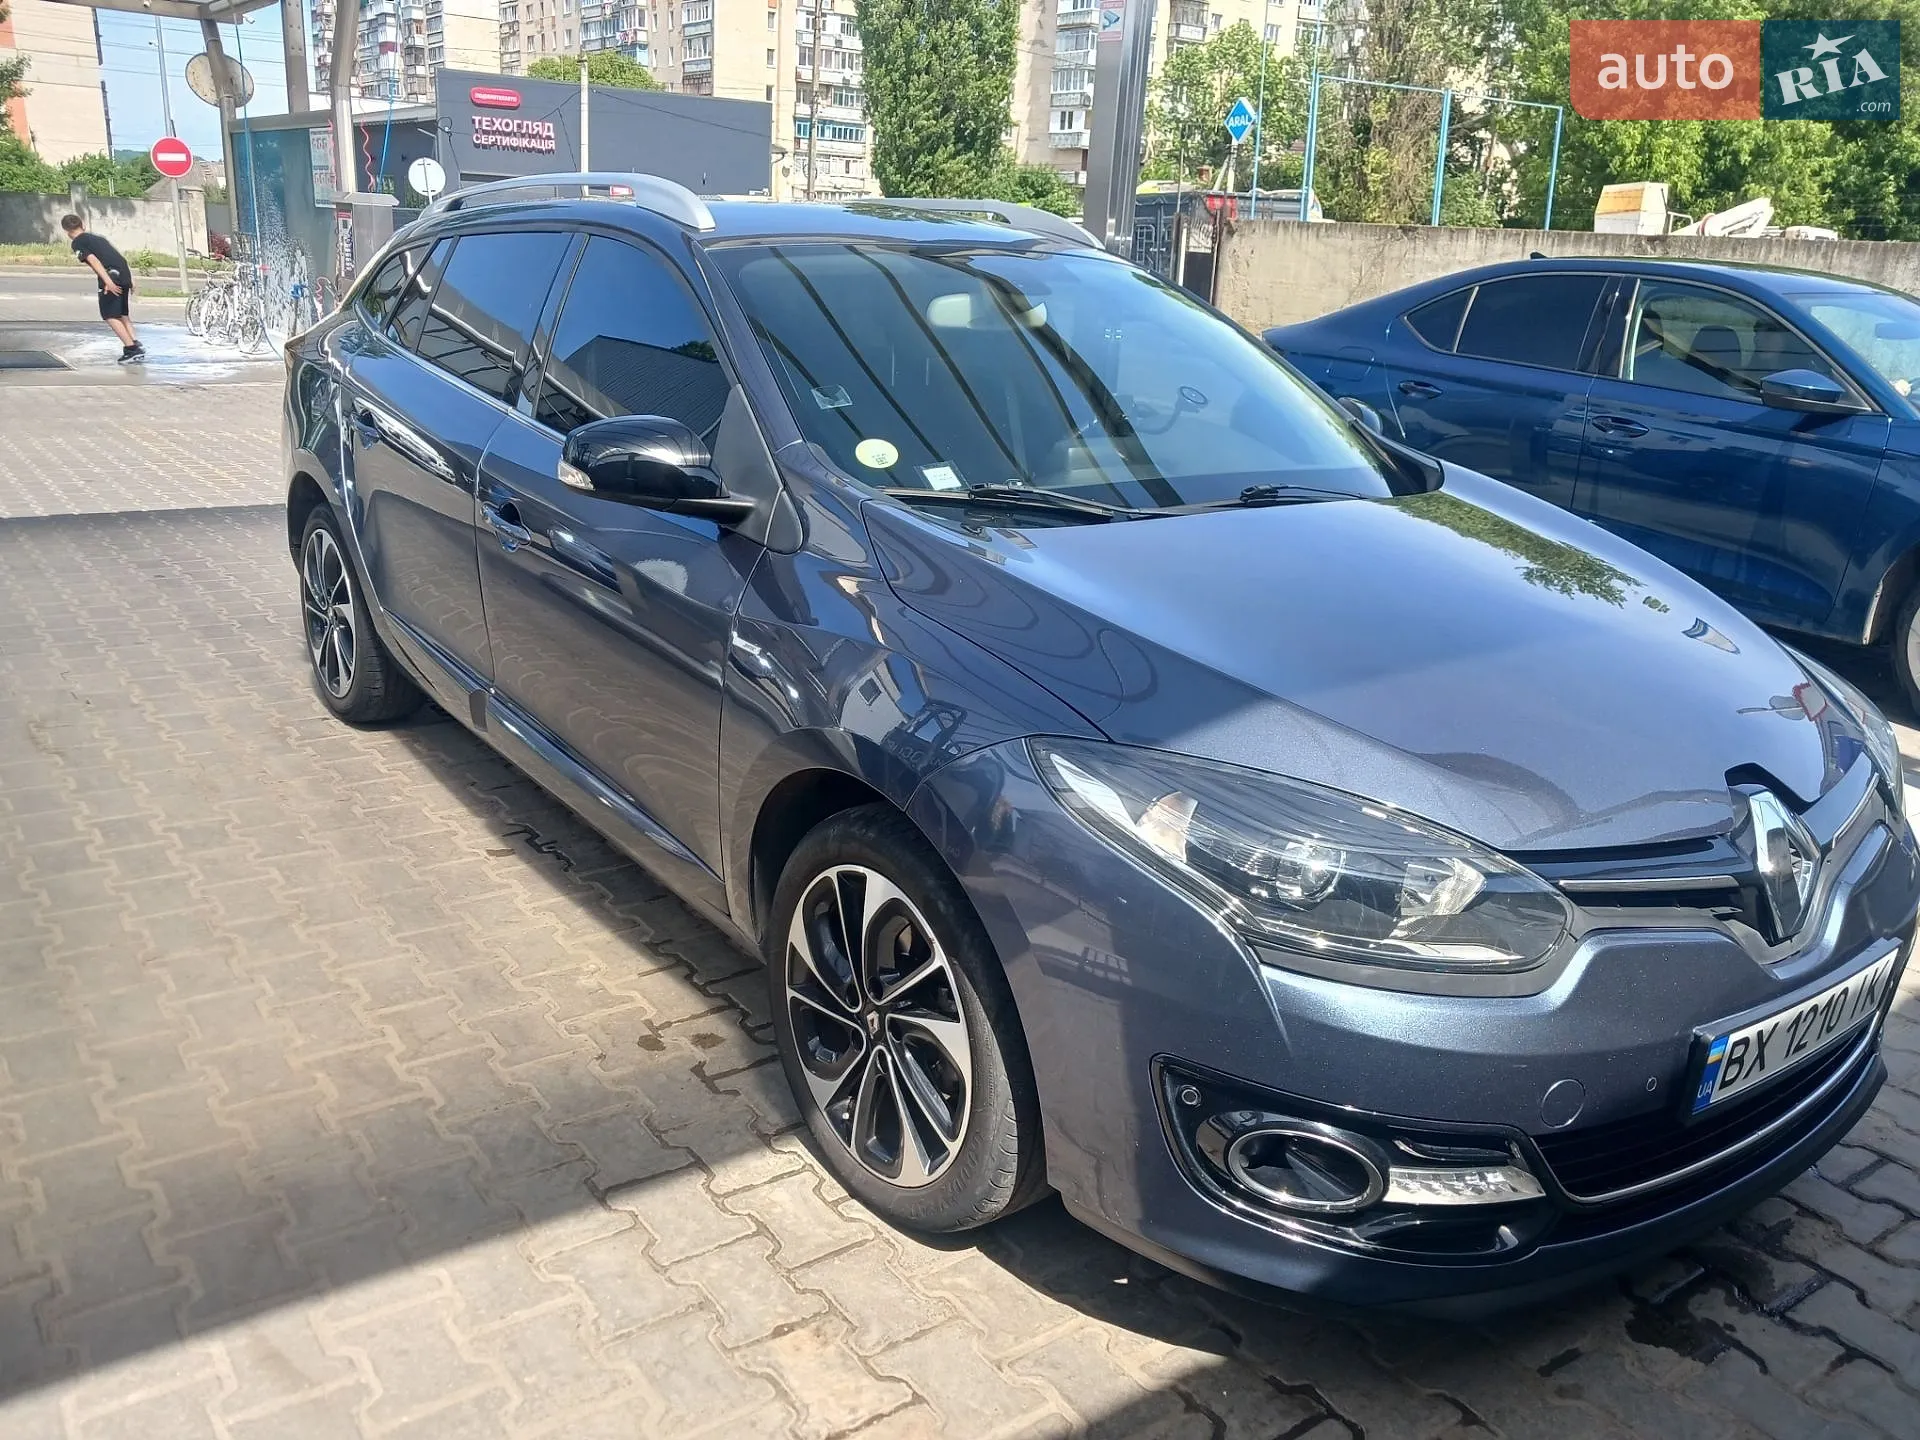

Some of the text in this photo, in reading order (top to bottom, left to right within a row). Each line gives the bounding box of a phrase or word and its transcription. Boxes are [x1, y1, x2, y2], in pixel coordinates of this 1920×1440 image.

[472, 116, 555, 139] ТЕХОГЛЯД
[1228, 114, 1250, 127] ARAL
[473, 133, 556, 150] СЕРТИФІКАЦІЯ
[1718, 1021, 1779, 1091] BX
[1784, 986, 1849, 1059] 1210
[1697, 1080, 1713, 1099] UA
